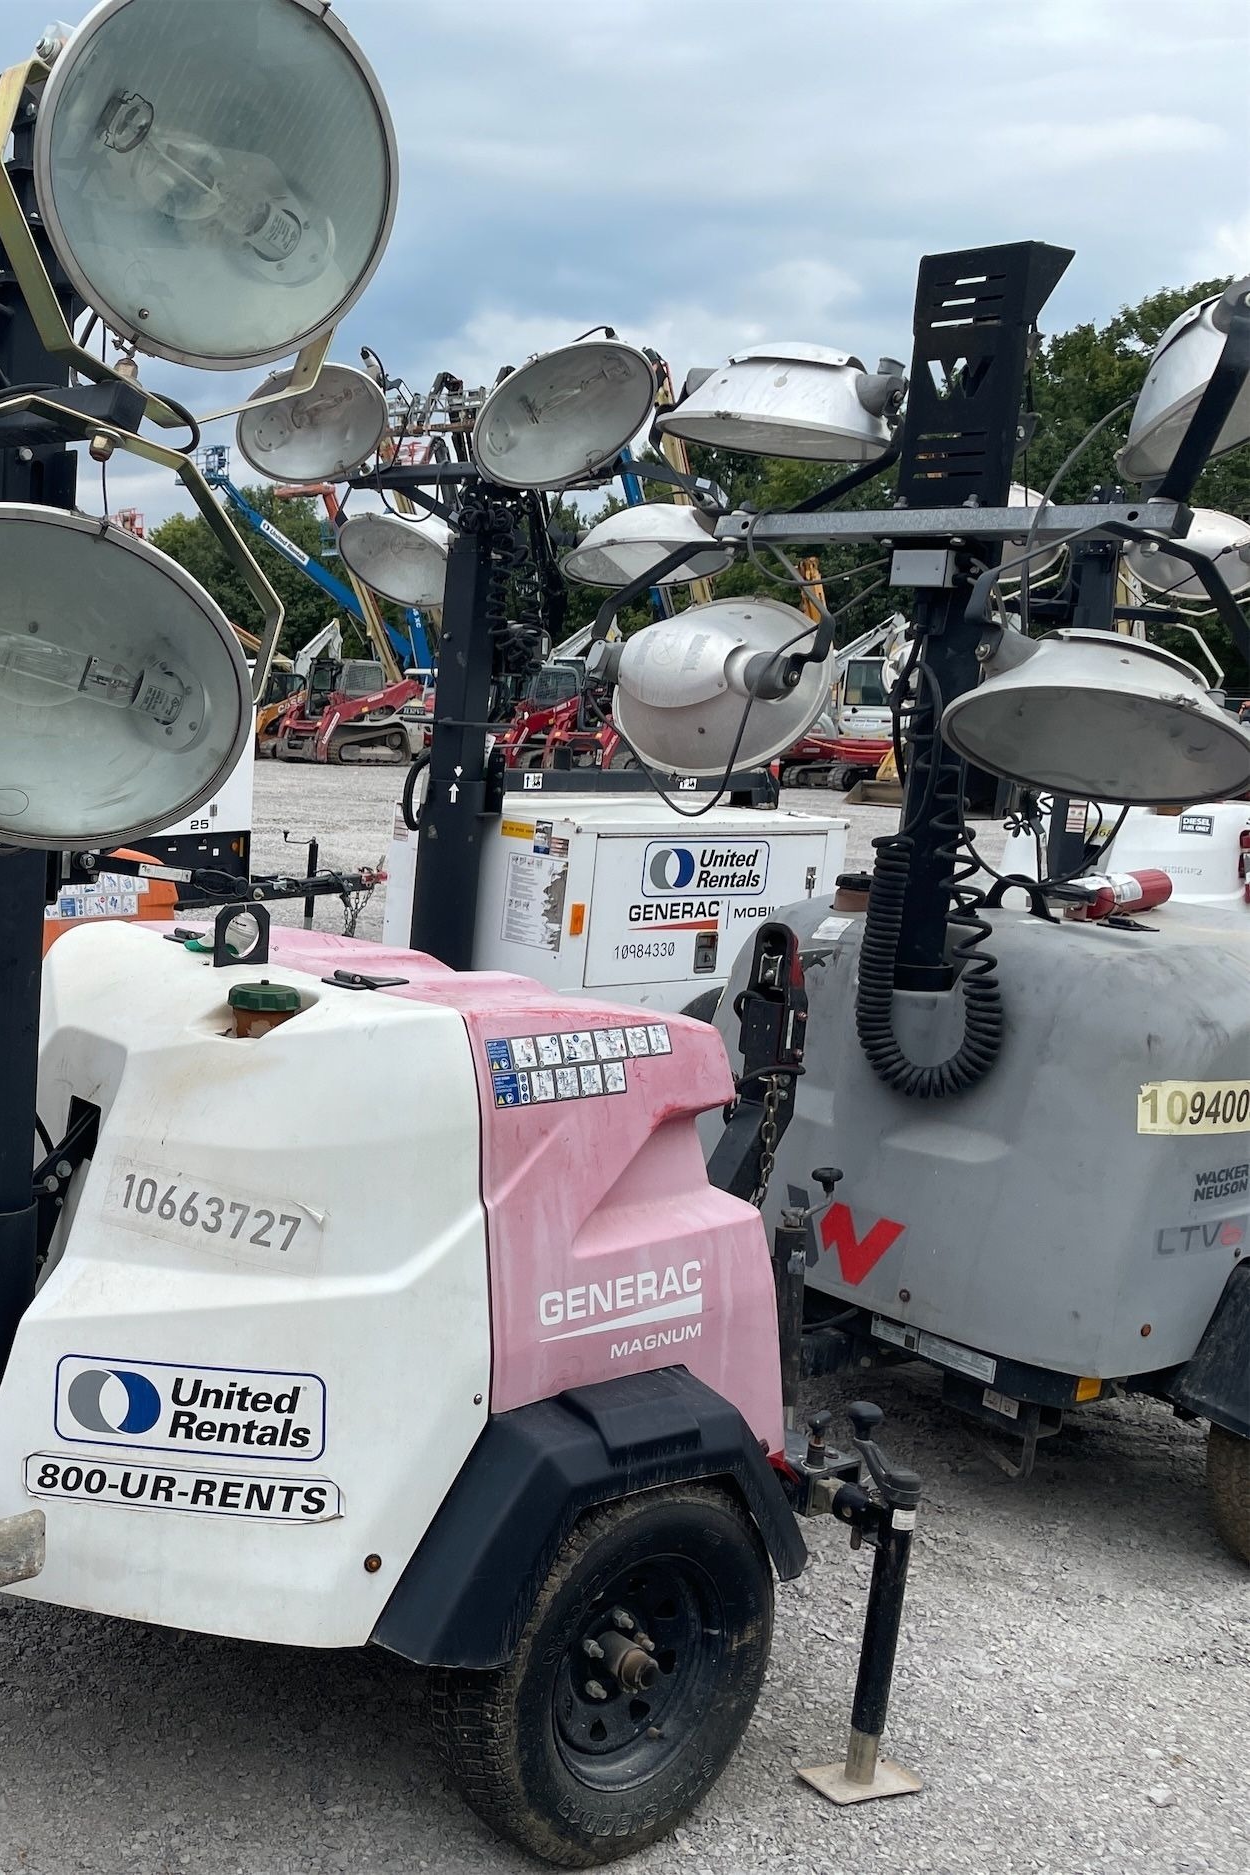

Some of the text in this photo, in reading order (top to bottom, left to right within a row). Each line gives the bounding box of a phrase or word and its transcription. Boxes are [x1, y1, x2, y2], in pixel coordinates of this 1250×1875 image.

[270, 528, 306, 562] United Rentals
[277, 694, 304, 714] CASE
[190, 819, 210, 830] 25
[1183, 817, 1211, 826] DIESEL
[699, 849, 759, 867] United
[696, 870, 761, 888] Rentals
[628, 900, 720, 922] GENERAC
[614, 942, 676, 960] 10984330
[1141, 1089, 1250, 1126] 109400
[1196, 1164, 1249, 1187] WACKER
[1193, 1178, 1248, 1202] NEUSON
[123, 1174, 302, 1251] 10663727
[539, 1260, 702, 1327] GENERAC
[610, 1322, 702, 1359] MAGNUM
[171, 1377, 301, 1414] United
[168, 1410, 312, 1449] Rentals
[37, 1463, 328, 1515] 800-UR-RENTS
